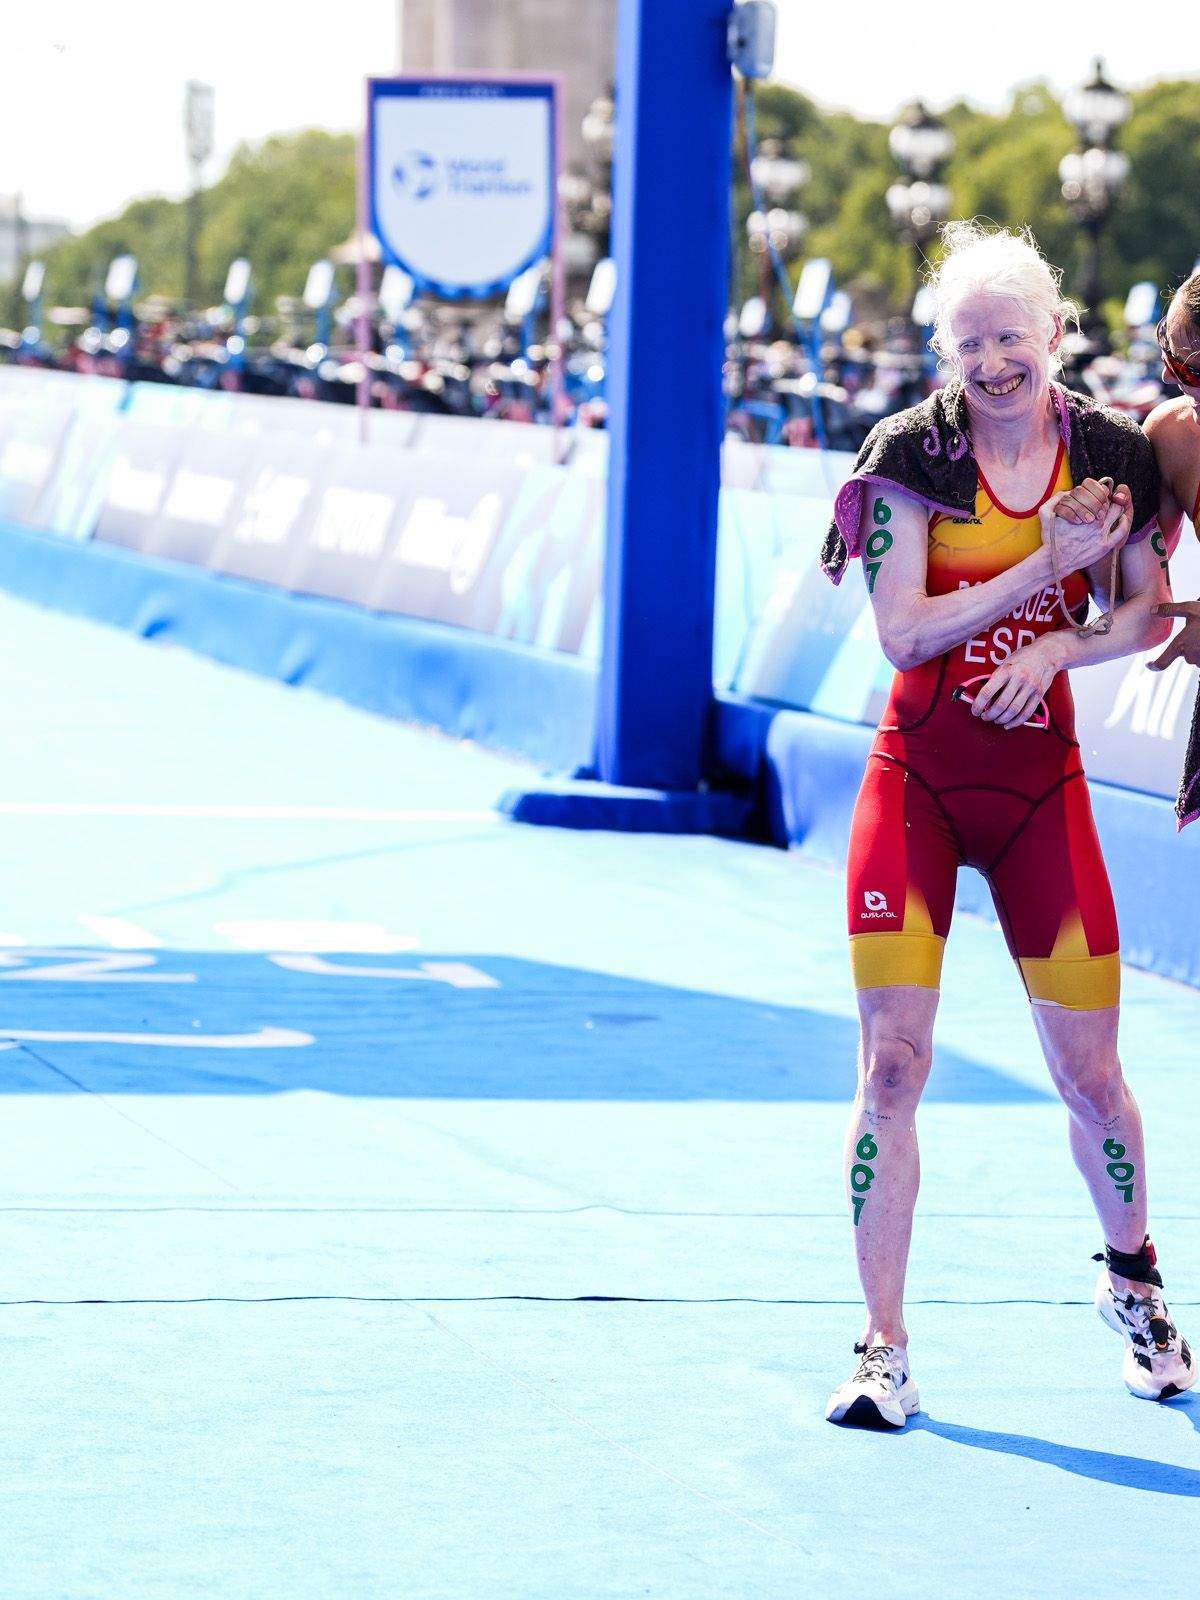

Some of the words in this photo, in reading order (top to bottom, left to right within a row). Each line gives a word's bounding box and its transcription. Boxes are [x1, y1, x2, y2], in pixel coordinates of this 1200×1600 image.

[866, 497, 894, 594] 607
[860, 911, 899, 919] austral
[850, 1132, 879, 1228] 607
[1102, 1137, 1136, 1204] 607
